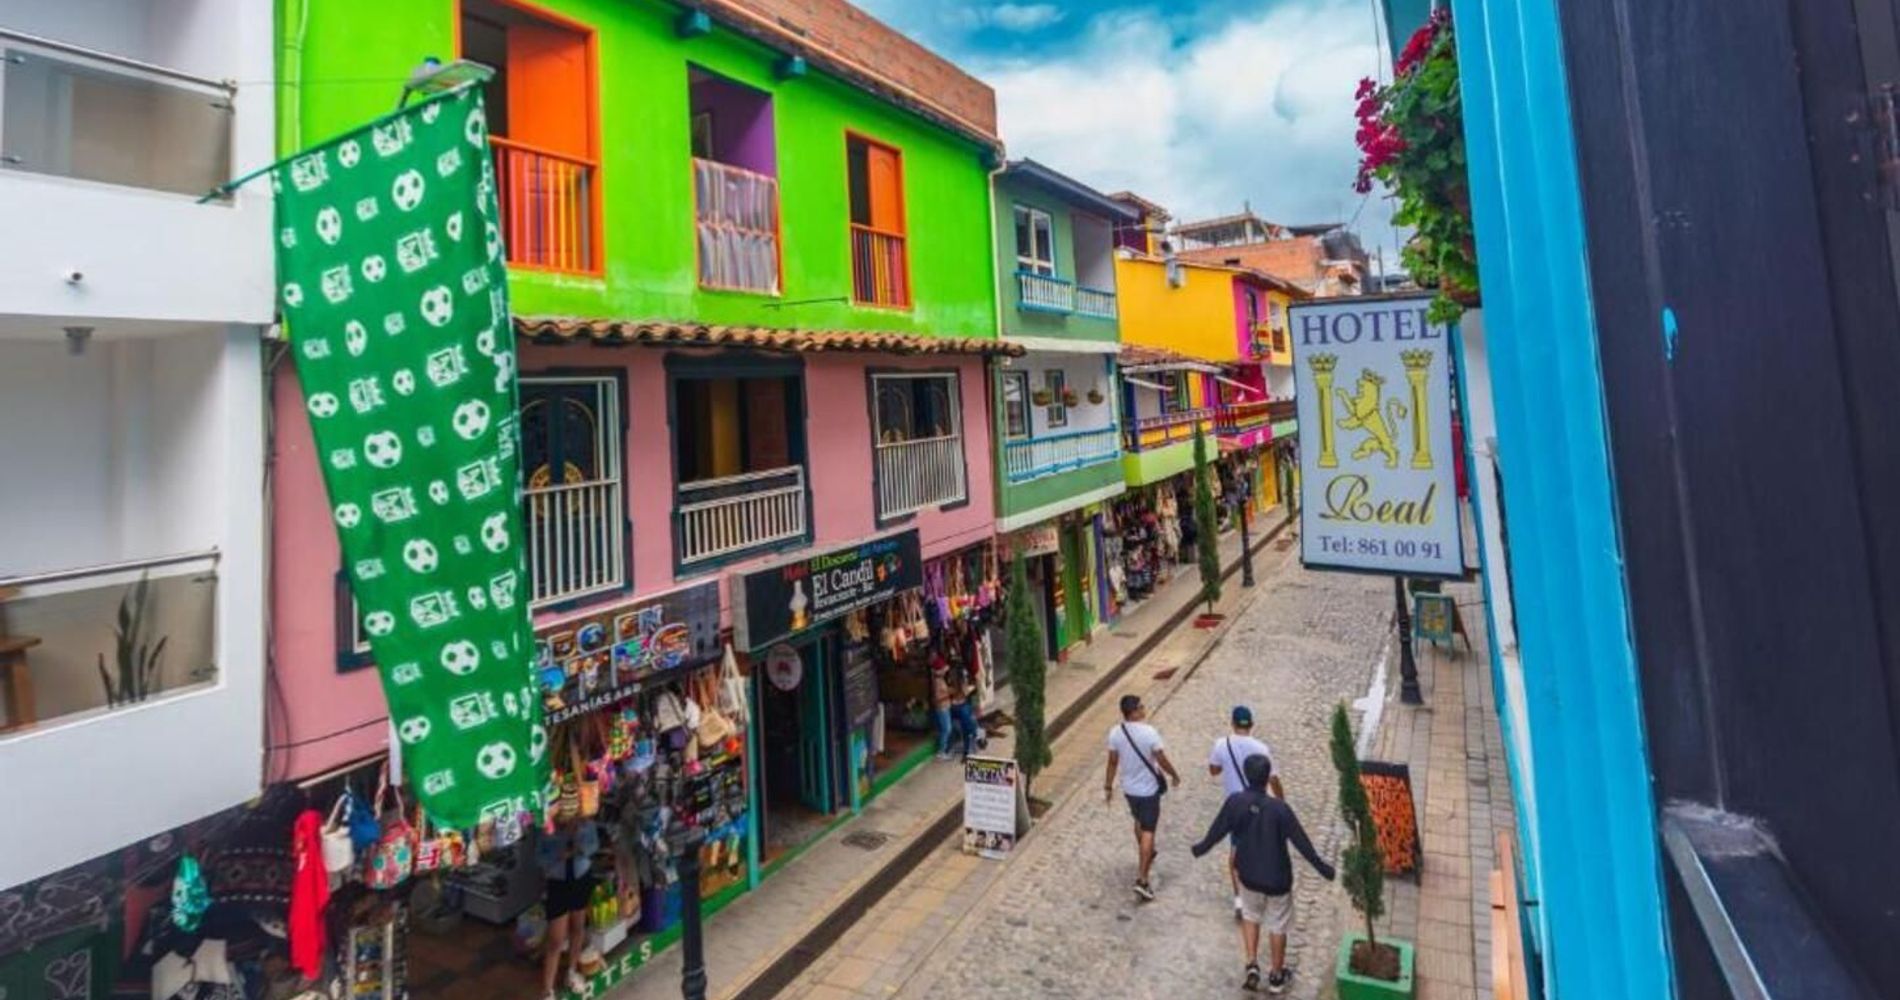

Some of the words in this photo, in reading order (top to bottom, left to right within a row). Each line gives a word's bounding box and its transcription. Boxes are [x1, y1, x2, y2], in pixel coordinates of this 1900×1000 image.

[1300, 308, 1441, 345] HOTEL
[1318, 474, 1437, 526] Real
[1318, 535, 1353, 553] Tel:
[1357, 539, 1388, 556] 861
[1395, 541, 1416, 558] 00
[1421, 542, 1442, 559] 91
[812, 572, 829, 598] El
[831, 559, 874, 591] Candil
